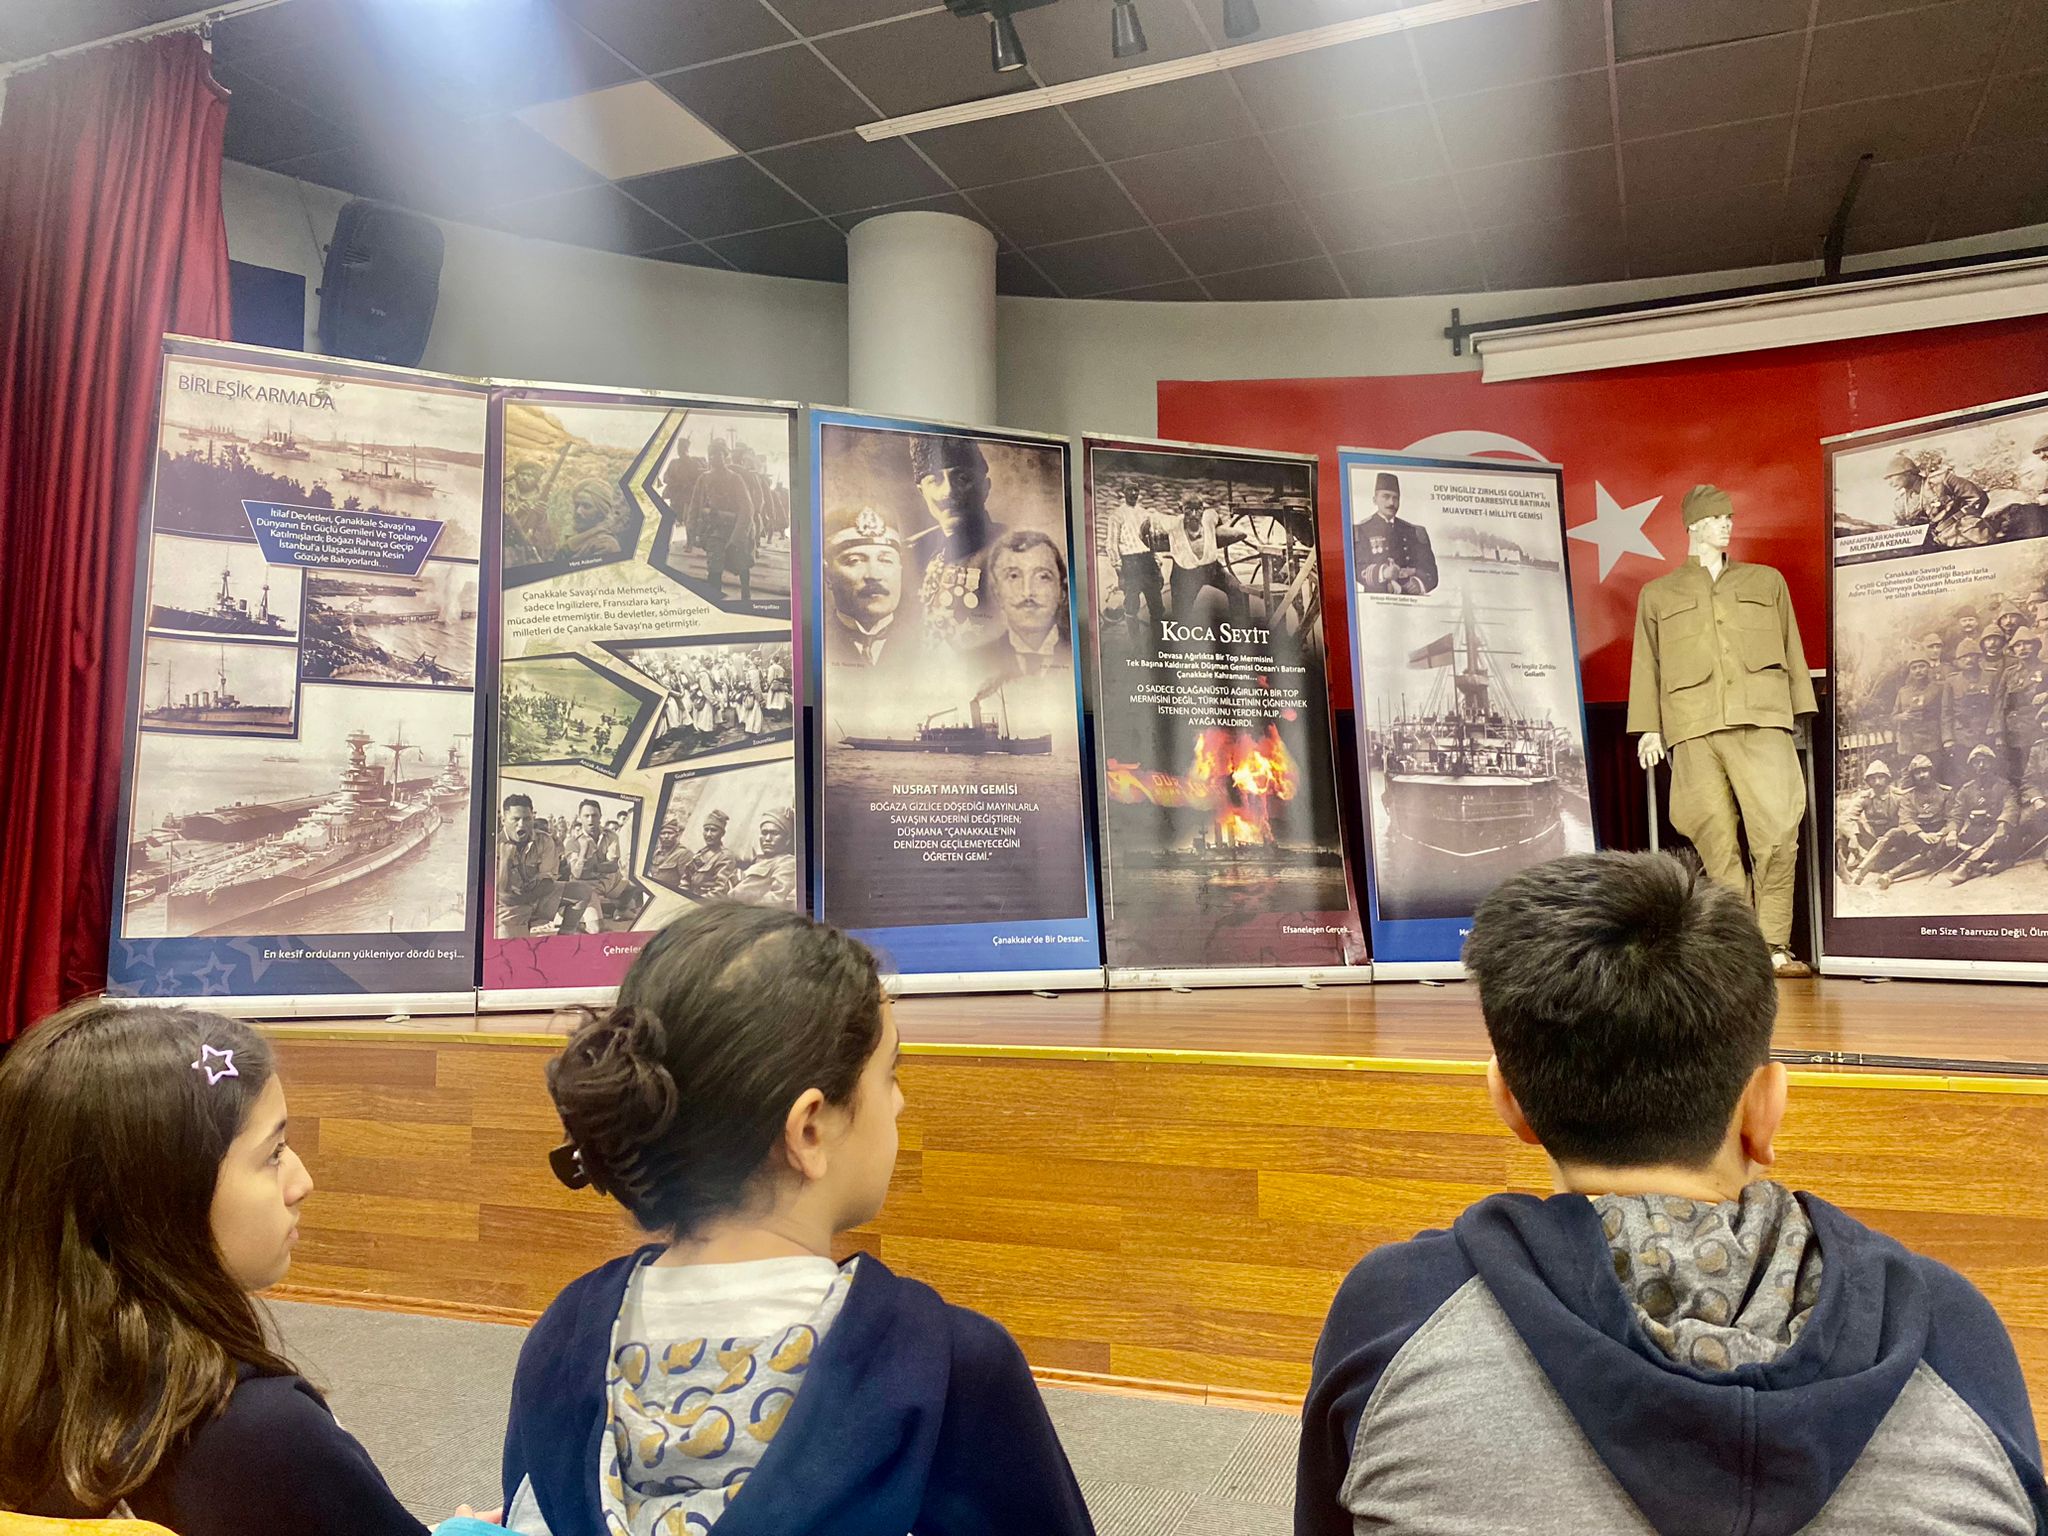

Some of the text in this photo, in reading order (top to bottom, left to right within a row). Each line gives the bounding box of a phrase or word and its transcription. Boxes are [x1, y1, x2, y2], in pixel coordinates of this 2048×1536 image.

[178, 375, 334, 409] BİRLEŞİK ARMADA
[1450, 485, 1476, 494] İNGİLİZ
[1478, 487, 1507, 496] ZIRHLISI
[1475, 496, 1518, 506] DARBESİYLE
[271, 508, 415, 531] İtilaf Devletleri, Çanakkale Savaşı'na
[1489, 509, 1517, 518] MİLLİYE
[1518, 511, 1543, 520] GEMİSİ
[257, 518, 298, 528] Dünyanın
[313, 524, 338, 534] Güçlü
[339, 526, 374, 537] Gemileri
[389, 532, 427, 543] Toplarıyla
[326, 535, 354, 546] Boğazı
[356, 538, 388, 548] Rahatça
[390, 542, 414, 552] Geçip
[1840, 529, 1922, 546] ANAFARTALAR KAHRAMANI
[1850, 538, 1911, 552] MUSTAFA KEMAL
[294, 552, 328, 563] Gözüyle
[322, 544, 380, 557] Ulaşacaklarına
[382, 551, 404, 559] Kesin
[1914, 581, 1942, 590] Duyuran
[1974, 573, 1996, 581] Kemal
[523, 585, 666, 600] Çanakkale Savaşı'nda Mehmetçik,
[524, 604, 554, 612] sadece
[603, 598, 648, 607] Fransızlara
[651, 598, 670, 606] karşı
[507, 615, 551, 625] mücadele
[617, 610, 657, 618] devletler,
[659, 606, 710, 616] sömürgeleri
[513, 627, 551, 637] milletleri
[567, 623, 612, 634] Çanakkale
[614, 622, 652, 631] Savaşı'na
[1158, 651, 1182, 660] Devasa
[1184, 653, 1214, 661] Ağırlıkta
[1226, 654, 1238, 662] Top
[1141, 660, 1163, 668] Başına
[1201, 662, 1228, 670] Düşman
[1177, 671, 1213, 679] Çanakkale
[1146, 684, 1174, 693] SADECE
[1176, 685, 1229, 695] OLAĞANÜSTÜ
[1231, 688, 1268, 696] AĞIRLIKTA
[1270, 688, 1282, 697] BİR
[1130, 694, 1170, 704] MERMİSİNİ
[1198, 696, 1219, 704] TÜRK
[1220, 697, 1260, 706] MİLLETİNİN
[1262, 698, 1307, 708] ÇİĞNENMEK
[1158, 705, 1189, 714] İSTENEN
[1191, 707, 1230, 715] ONURUNU
[1232, 708, 1262, 717] YERDEN
[1188, 717, 1216, 726] AYAĞA
[893, 783, 1018, 794] NUSRAT MAYIN GEMİSİ
[870, 802, 1040, 812] BOĞAZA GİZLİCE DÖŞEDİĞİ MAYINLARLA
[891, 815, 927, 825] SAVAŞIN
[930, 814, 969, 823] KADERİNİ
[898, 826, 942, 838] DÜŞMANA
[894, 839, 1020, 850] DENİZDEN GEÇİLEMEYECEĞİNİ
[923, 852, 964, 861] ÖĞRETEN
[1283, 926, 1324, 935] Efsaneleşen
[1920, 927, 1937, 935] Ben
[1939, 927, 1958, 935] Size
[1960, 928, 1999, 936] Taarruzu
[2001, 928, 2028, 938] Değil,
[992, 936, 1043, 946] Çanakkale'de
[264, 950, 276, 959] En
[279, 949, 303, 959] kesif
[305, 949, 350, 959] orduların
[353, 950, 404, 961] yükleniyor
[407, 950, 435, 959] dördü
